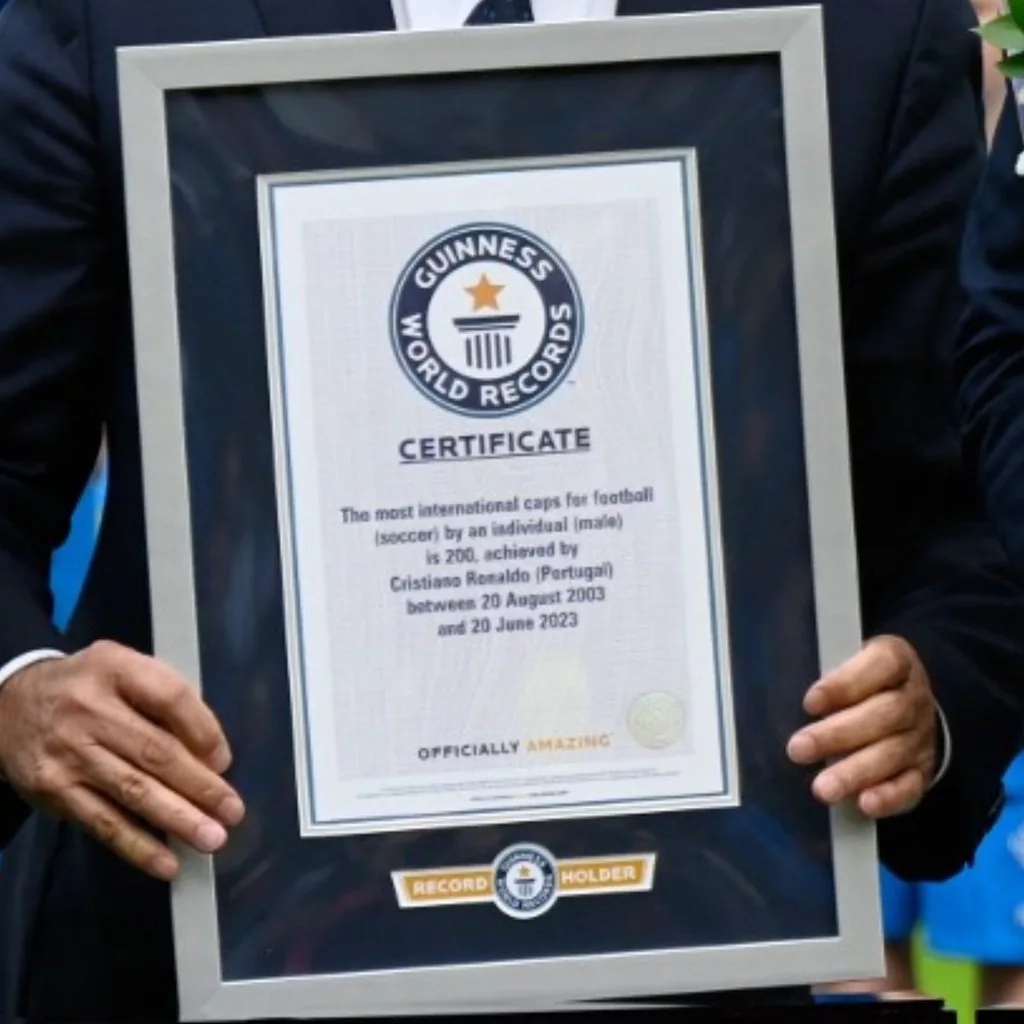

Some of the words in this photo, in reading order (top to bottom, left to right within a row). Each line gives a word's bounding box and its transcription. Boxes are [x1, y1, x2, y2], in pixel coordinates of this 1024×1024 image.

[414, 234, 554, 290] GUINNESS
[400, 314, 469, 401] WORLD
[480, 302, 573, 407] RECORDS
[398, 426, 591, 466] CERTIFICATE
[340, 507, 371, 524] The
[375, 505, 414, 521] most
[418, 496, 519, 518] international
[524, 497, 561, 515] caps
[566, 490, 588, 508] for
[593, 486, 654, 506] football
[375, 527, 440, 546] (soccer)
[444, 524, 463, 543] by
[468, 526, 487, 538] an
[492, 516, 568, 537] individual
[574, 513, 623, 532] (male)
[425, 549, 440, 565] is
[484, 542, 555, 561] achieved
[560, 542, 579, 560] by
[390, 573, 461, 593] Cristiano
[466, 569, 530, 587] Ronaldo
[536, 563, 614, 585] (Portugal)
[407, 596, 477, 615] between
[481, 594, 501, 610] 20
[506, 591, 562, 610] August
[566, 587, 606, 603] 2003
[437, 619, 466, 637] and
[471, 618, 491, 634] 20
[495, 615, 535, 633] June
[539, 612, 579, 630] 2023
[418, 740, 520, 761] OFFICIALLY
[527, 734, 611, 753] AMAZING
[412, 877, 488, 896] RECORD
[561, 866, 636, 884] HOLDER
